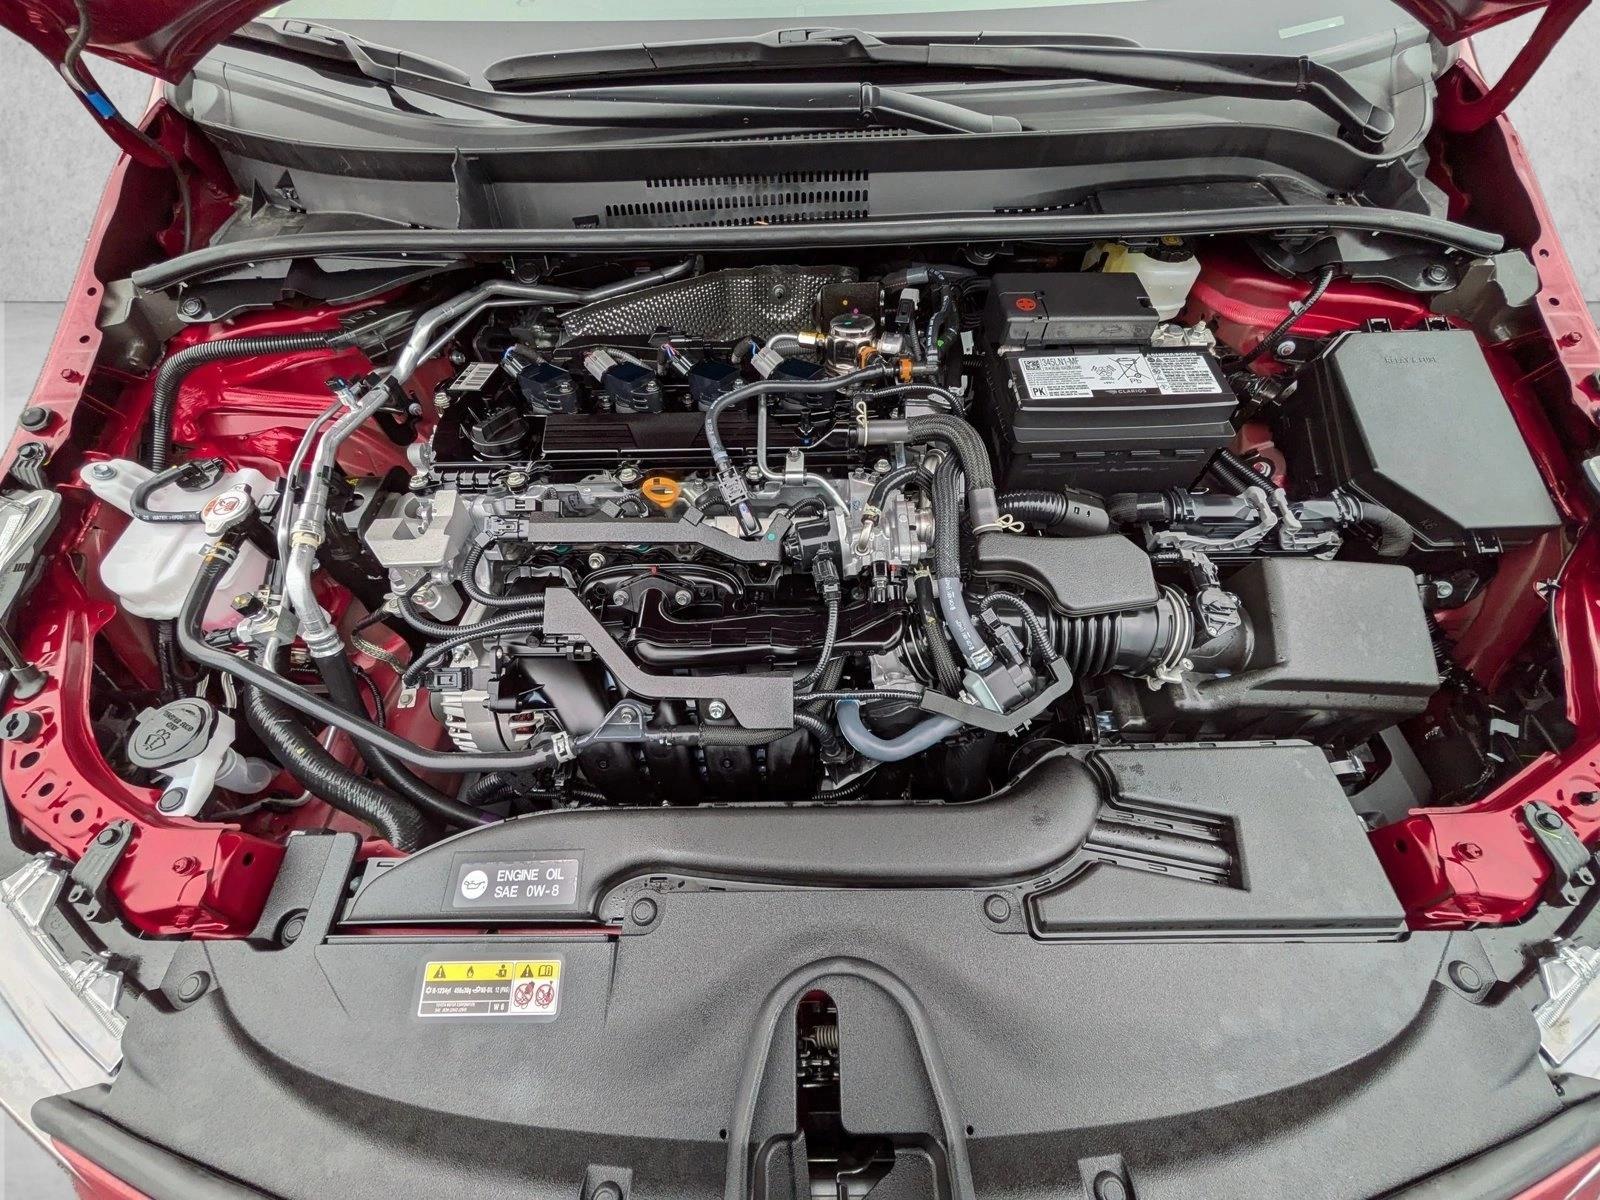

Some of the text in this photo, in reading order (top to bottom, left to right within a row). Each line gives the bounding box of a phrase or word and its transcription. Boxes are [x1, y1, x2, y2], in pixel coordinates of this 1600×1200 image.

[1033, 387, 1046, 396] PK
[496, 867, 565, 882] ENGINE OIL
[494, 884, 560, 898] SAE 0W-8
